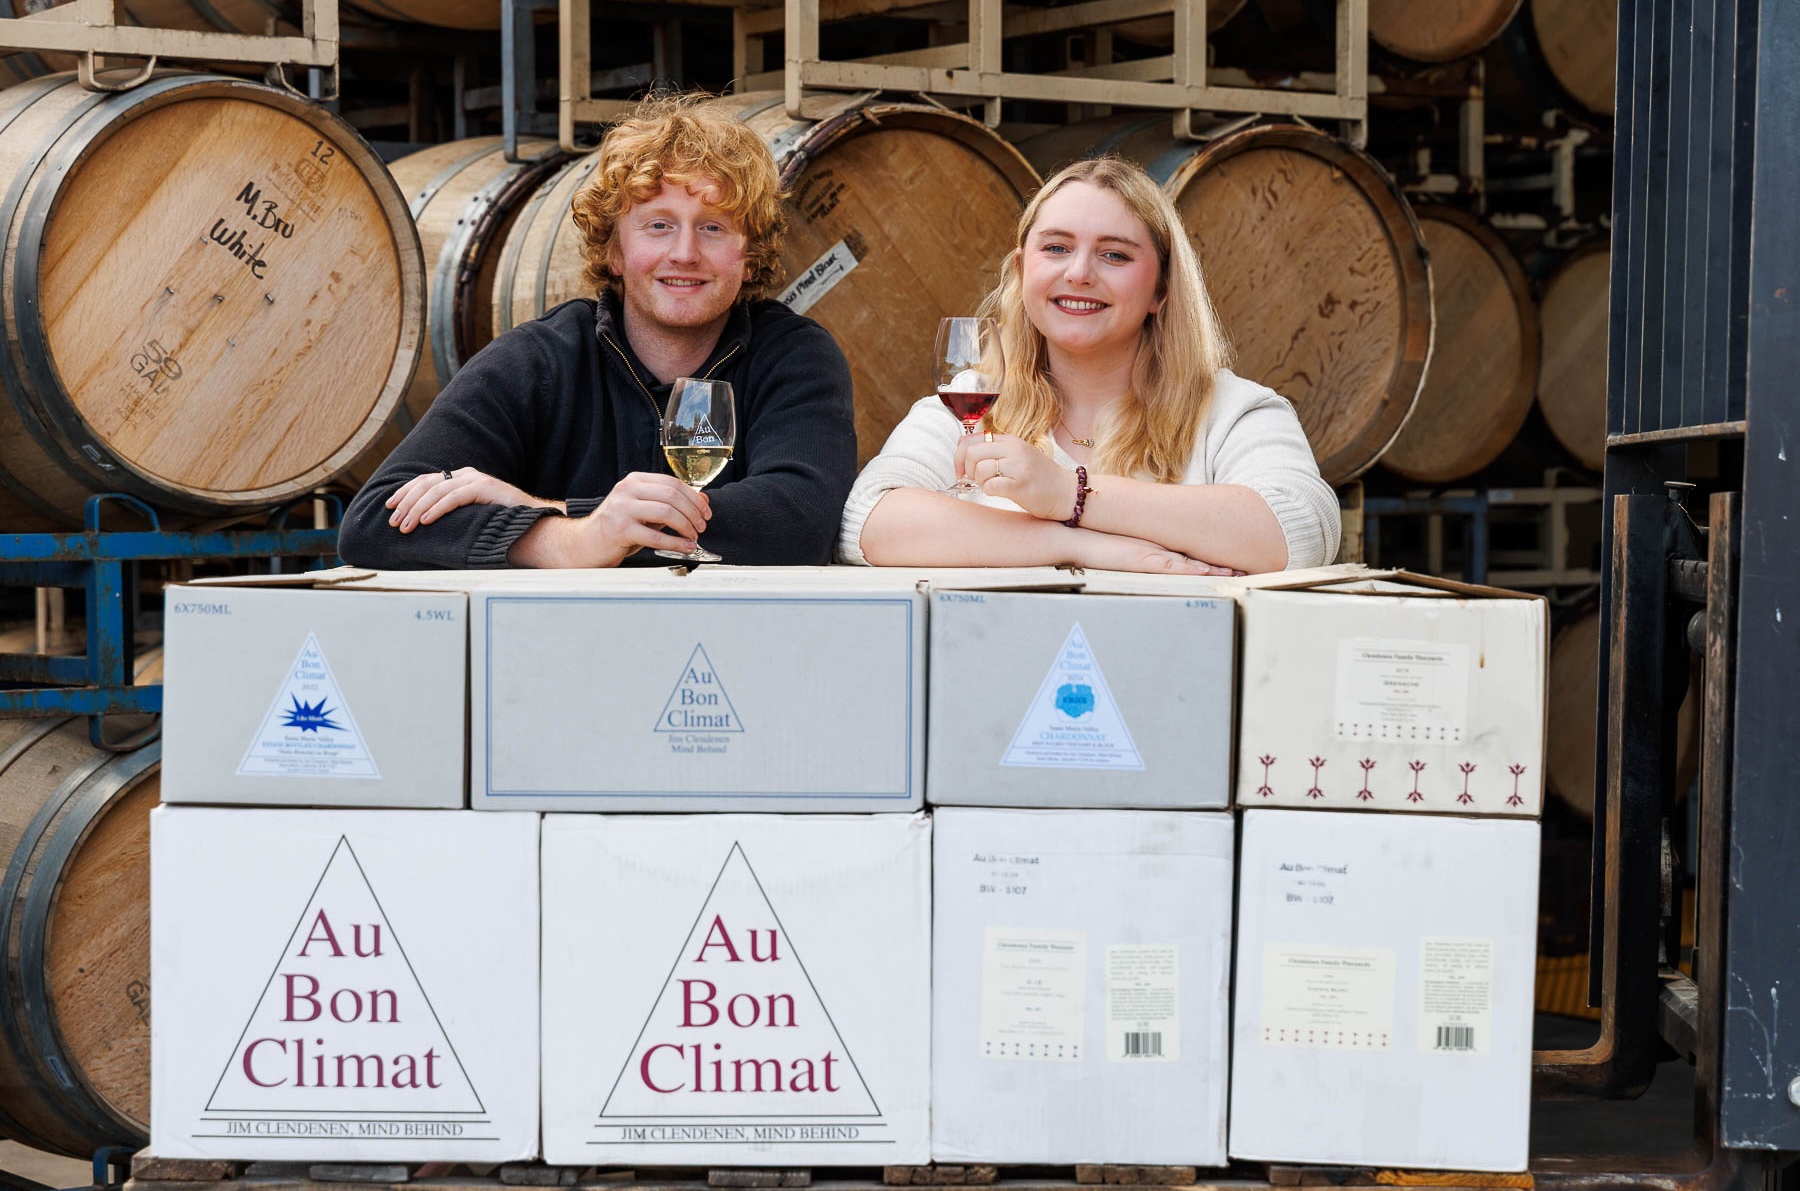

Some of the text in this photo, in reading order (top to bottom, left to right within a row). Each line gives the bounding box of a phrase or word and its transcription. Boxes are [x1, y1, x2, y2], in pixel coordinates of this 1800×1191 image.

[310, 140, 335, 165] 12
[209, 218, 267, 280] White
[143, 339, 182, 381] 59
[130, 353, 170, 395] GAL
[698, 425, 712, 434] Au
[696, 436, 715, 444] Bon
[174, 603, 232, 615] 6X750ML
[415, 610, 455, 621] 4.5WL
[304, 650, 318, 658] Au
[1066, 650, 1086, 659] Bon
[301, 660, 321, 669] Bon
[1059, 661, 1091, 670] Climat
[295, 671, 326, 680] Climat
[684, 667, 712, 684] Au
[681, 688, 718, 706] Bon
[667, 709, 731, 728] Climat
[296, 907, 384, 958] Au
[692, 914, 782, 963] Au
[279, 973, 402, 1023] Bon
[675, 979, 800, 1028] Bon
[242, 1037, 443, 1089] Climat
[640, 1042, 841, 1094] Climat
[226, 1121, 463, 1137] JIM CLENDENEN, MIND BEHIND
[621, 1127, 859, 1141] JIM CLENDENEN, MIND BEHIND
